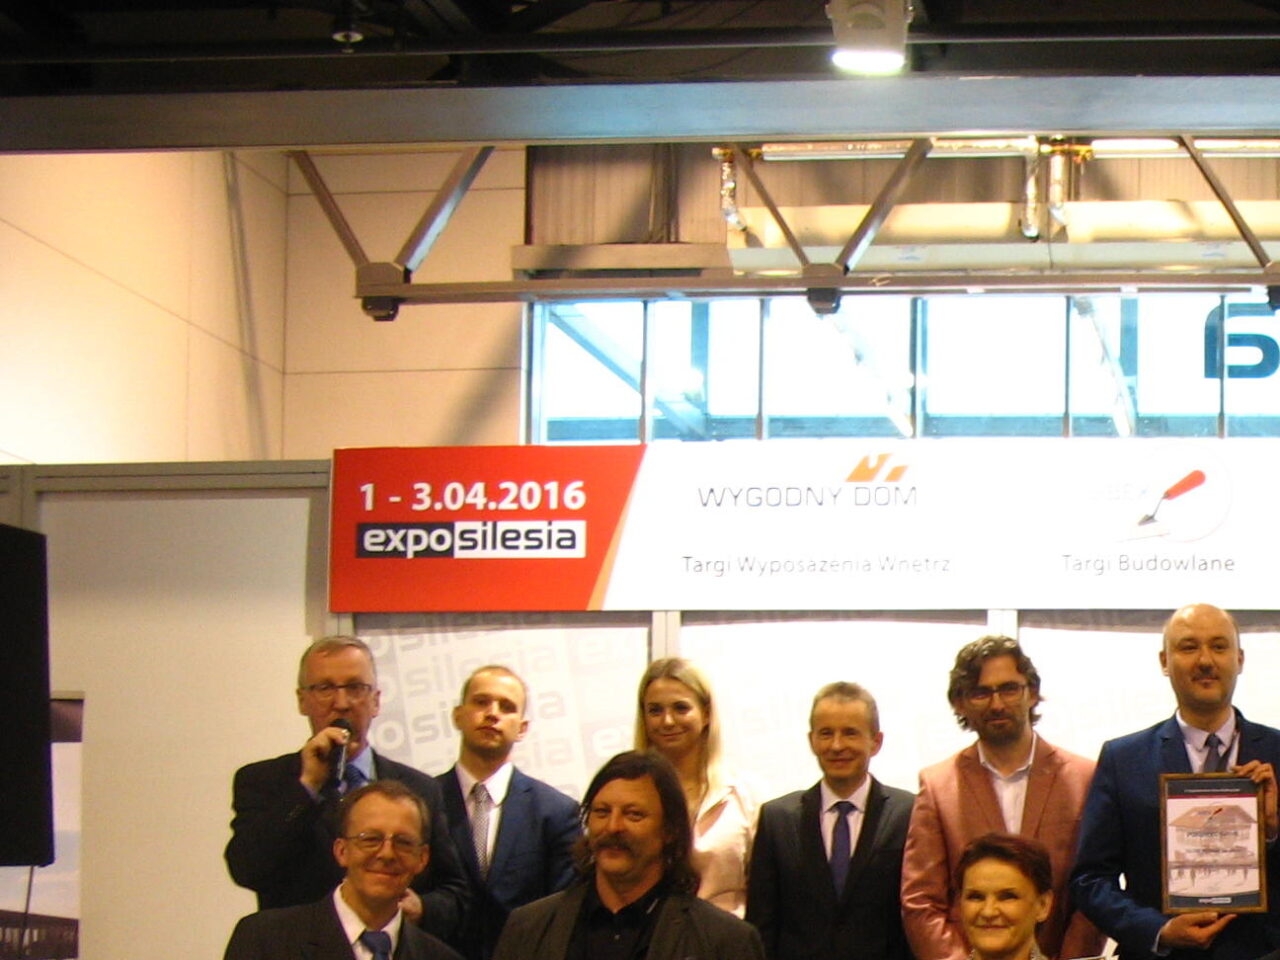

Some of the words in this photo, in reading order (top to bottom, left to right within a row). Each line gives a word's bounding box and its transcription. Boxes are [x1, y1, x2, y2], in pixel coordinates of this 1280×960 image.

[360, 482, 374, 511] 1
[411, 480, 586, 511] 3.04.2016
[698, 487, 841, 507] WYGODNY
[854, 486, 917, 506] DOM
[363, 520, 577, 559] exposilesia
[683, 556, 731, 578] Targi
[1062, 554, 1111, 575] Targi
[1118, 553, 1236, 572] Budowlane
